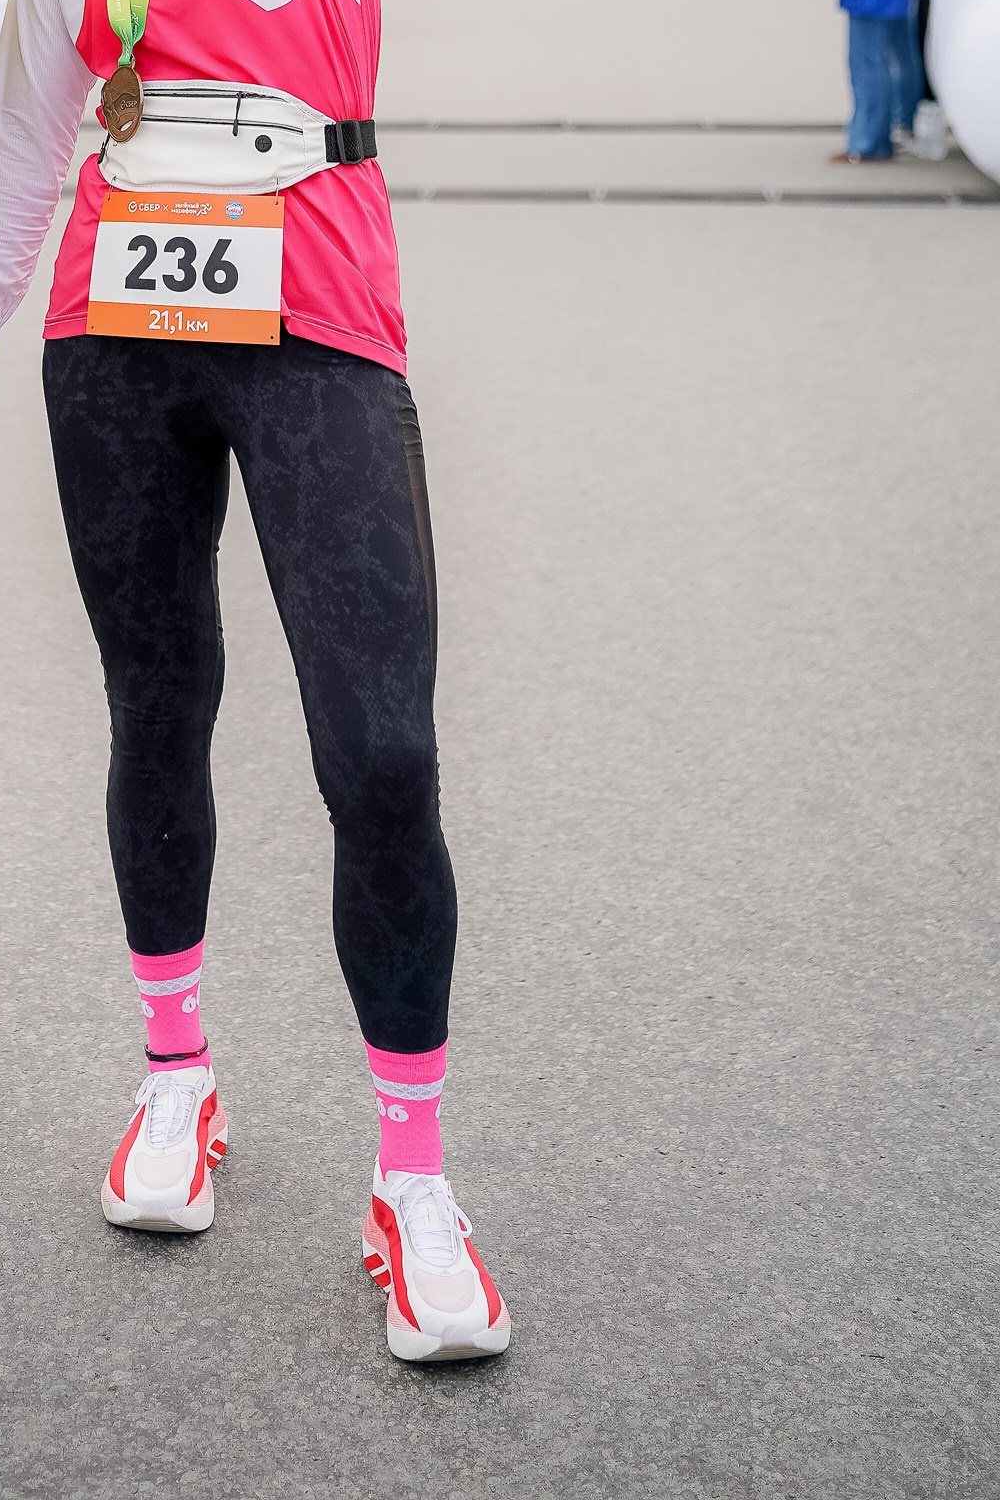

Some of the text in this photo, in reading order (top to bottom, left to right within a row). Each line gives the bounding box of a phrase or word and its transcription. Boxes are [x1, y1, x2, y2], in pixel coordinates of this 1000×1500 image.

[139, 203, 160, 212] СБЕР
[125, 235, 239, 295] 236
[148, 310, 184, 335] 21,1
